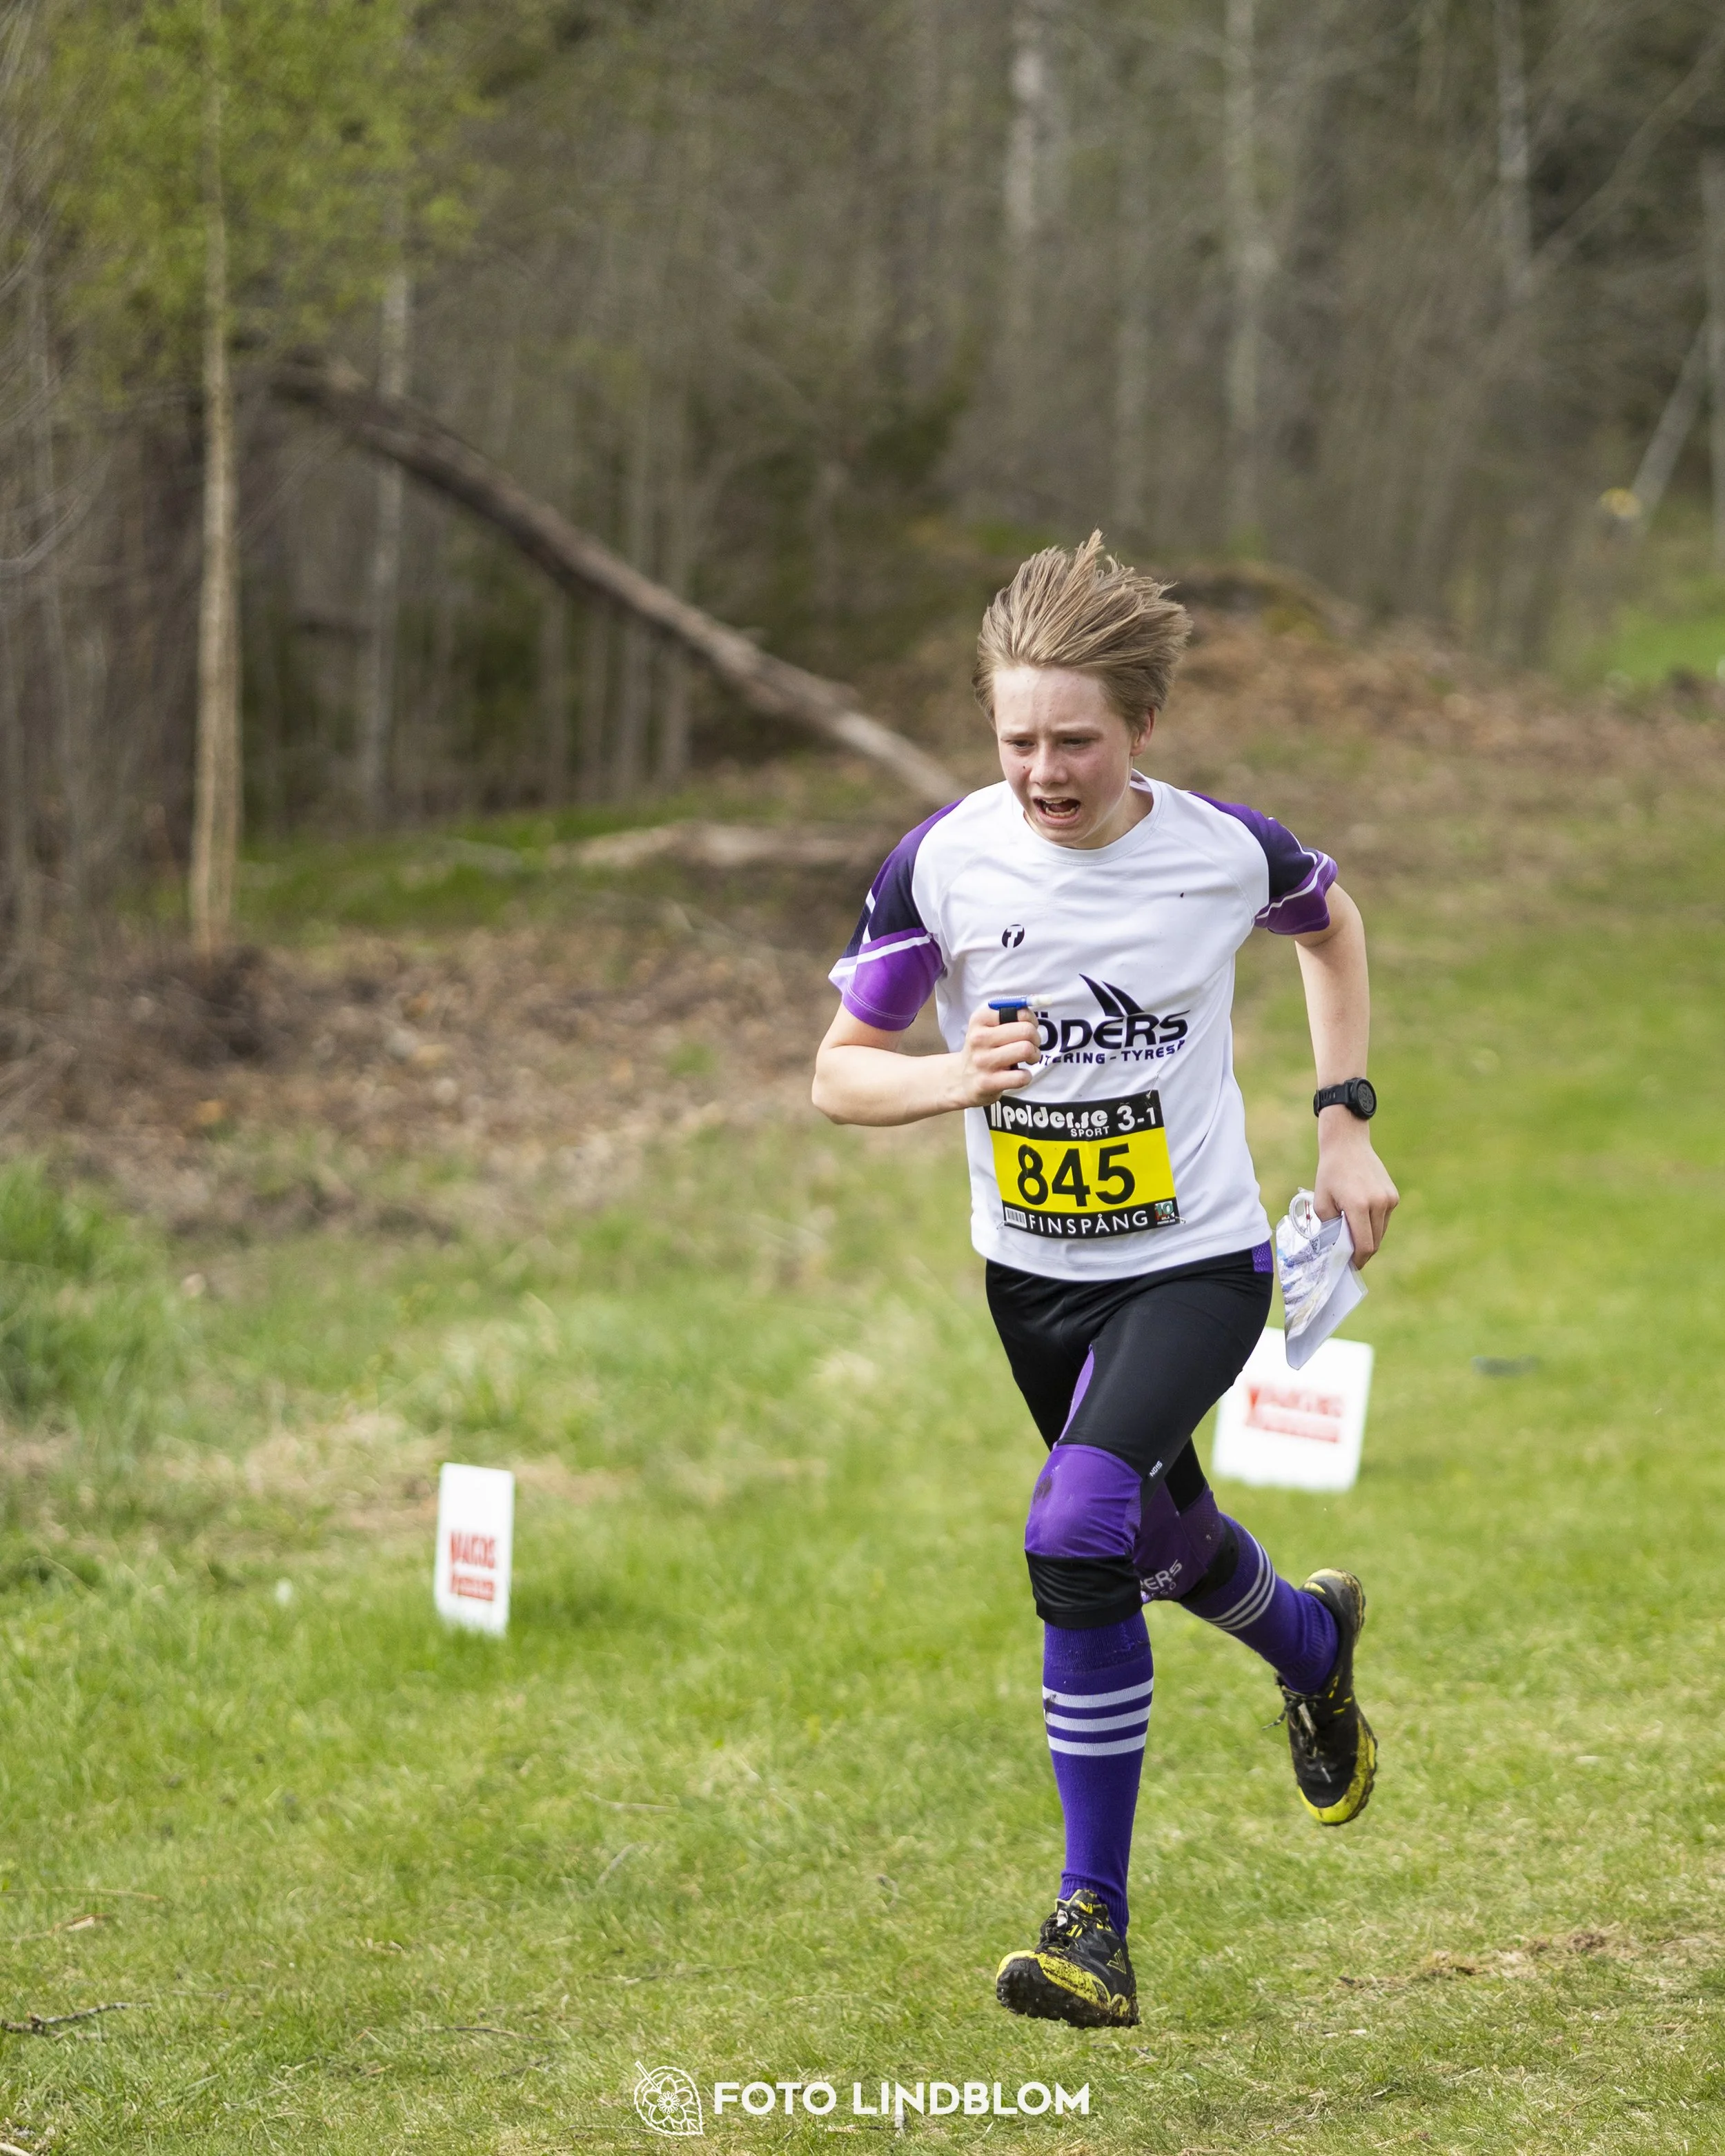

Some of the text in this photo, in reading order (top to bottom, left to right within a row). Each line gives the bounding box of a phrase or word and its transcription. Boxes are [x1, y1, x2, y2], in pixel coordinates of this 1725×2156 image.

[1034, 1009, 1191, 1053] ÖDERS
[1070, 1126, 1110, 1137] SPORT
[1116, 1105, 1156, 1131] 3-1
[1018, 1143, 1135, 1207] 845
[1029, 1210, 1148, 1234] FINSPÅNG
[1140, 1559, 1182, 1590] ERS
